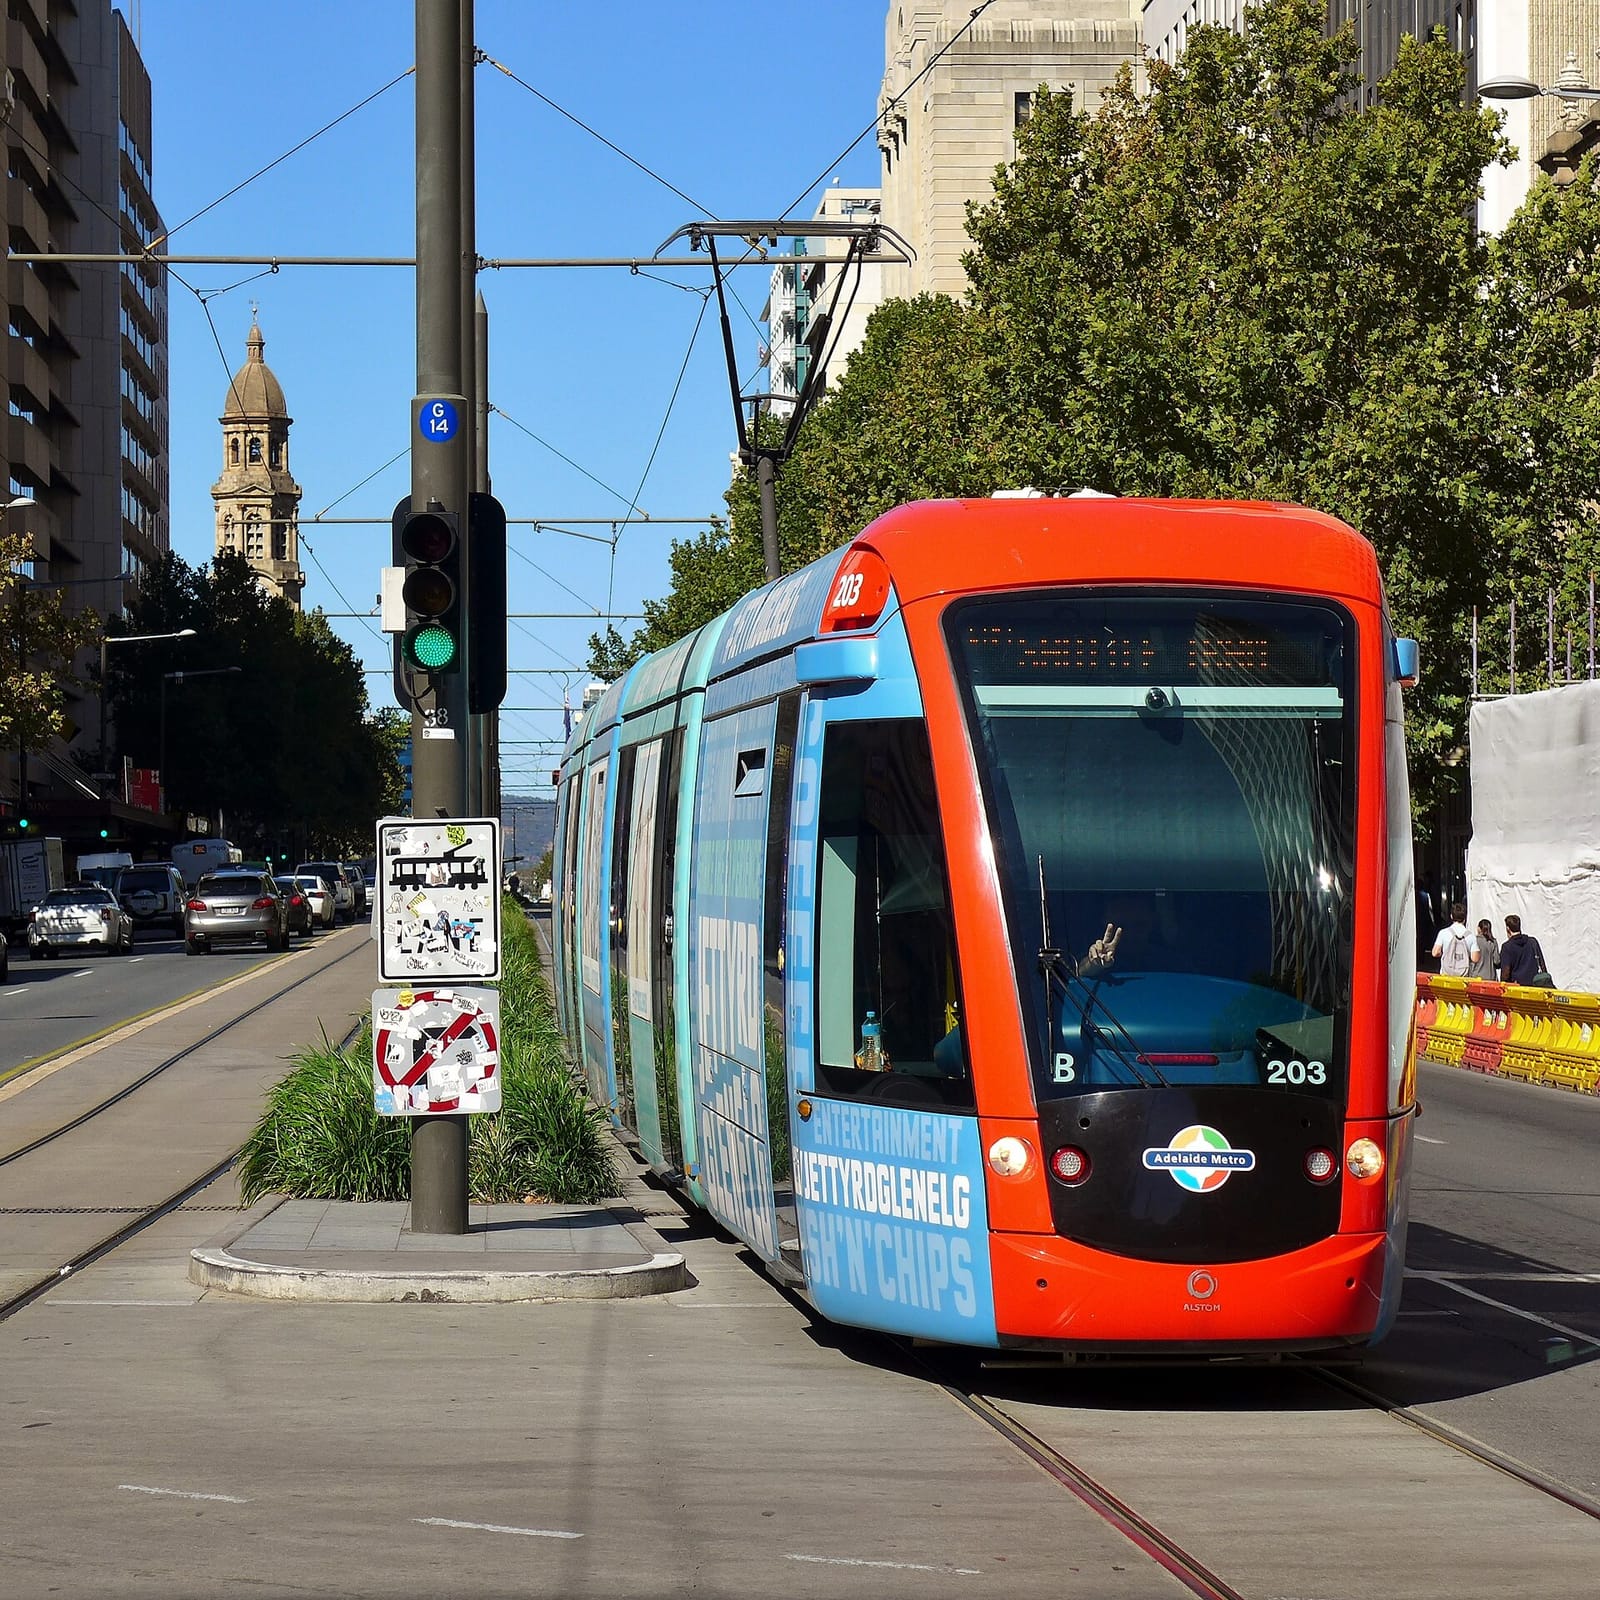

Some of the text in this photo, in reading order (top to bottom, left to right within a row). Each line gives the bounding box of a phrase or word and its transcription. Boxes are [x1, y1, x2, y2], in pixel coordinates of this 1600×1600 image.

[432, 403, 444, 418] G
[430, 419, 449, 433] 14
[832, 573, 864, 608] 203
[1053, 1053, 1075, 1083] B
[1267, 1060, 1327, 1085] 203
[814, 1102, 963, 1165] ENTERTAINMENT
[1154, 1153, 1246, 1165] Adelaide Metro
[1183, 1303, 1221, 1312] ALSTOM
